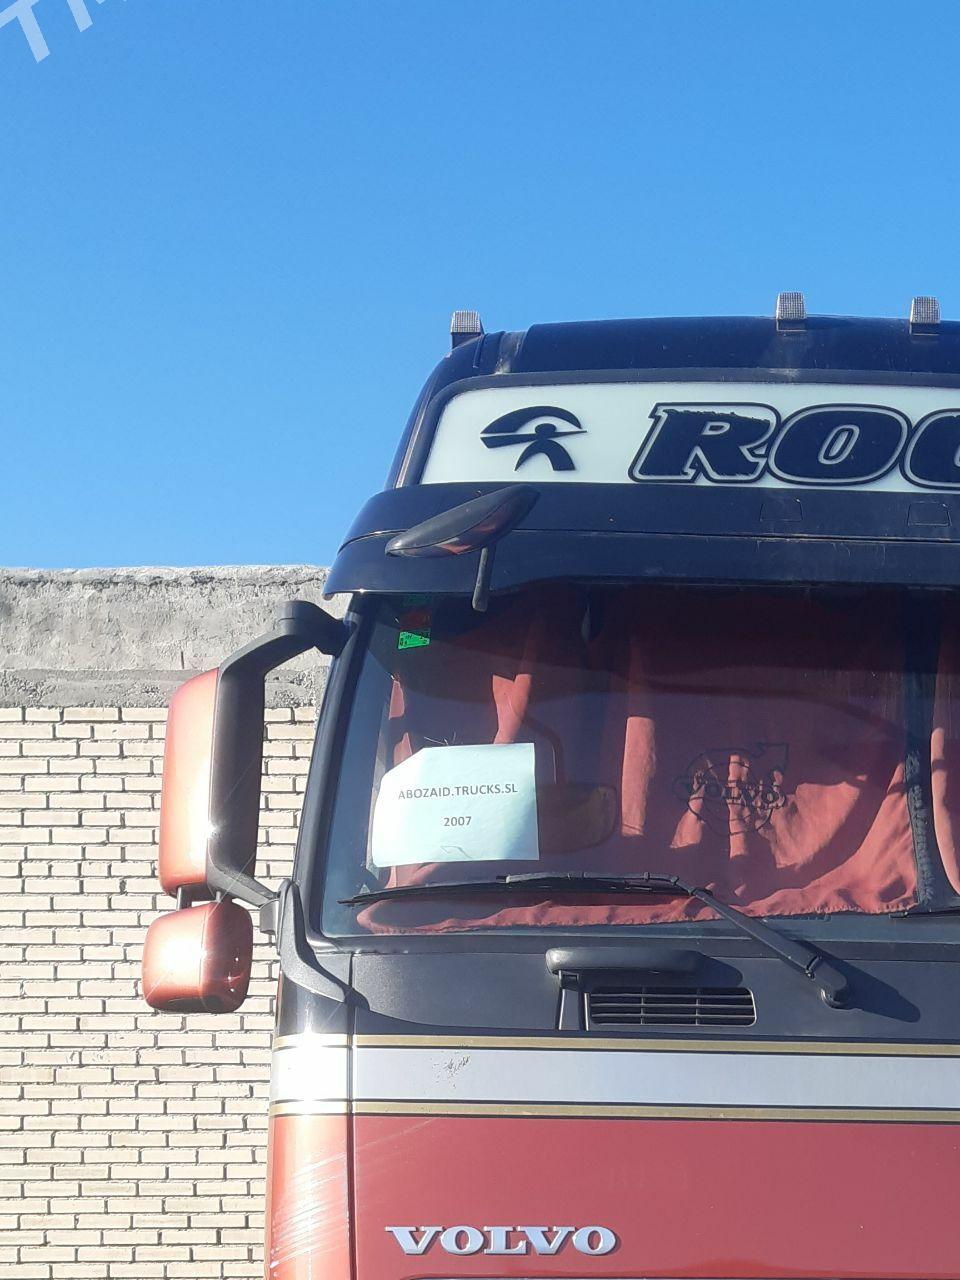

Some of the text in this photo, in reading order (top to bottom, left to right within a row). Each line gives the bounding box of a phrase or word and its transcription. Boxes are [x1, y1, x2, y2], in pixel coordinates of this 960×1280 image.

[398, 783, 518, 800] ABOZAID.TRUCKS.SL
[443, 816, 472, 827] 2007
[385, 1226, 616, 1255] VOLVO
